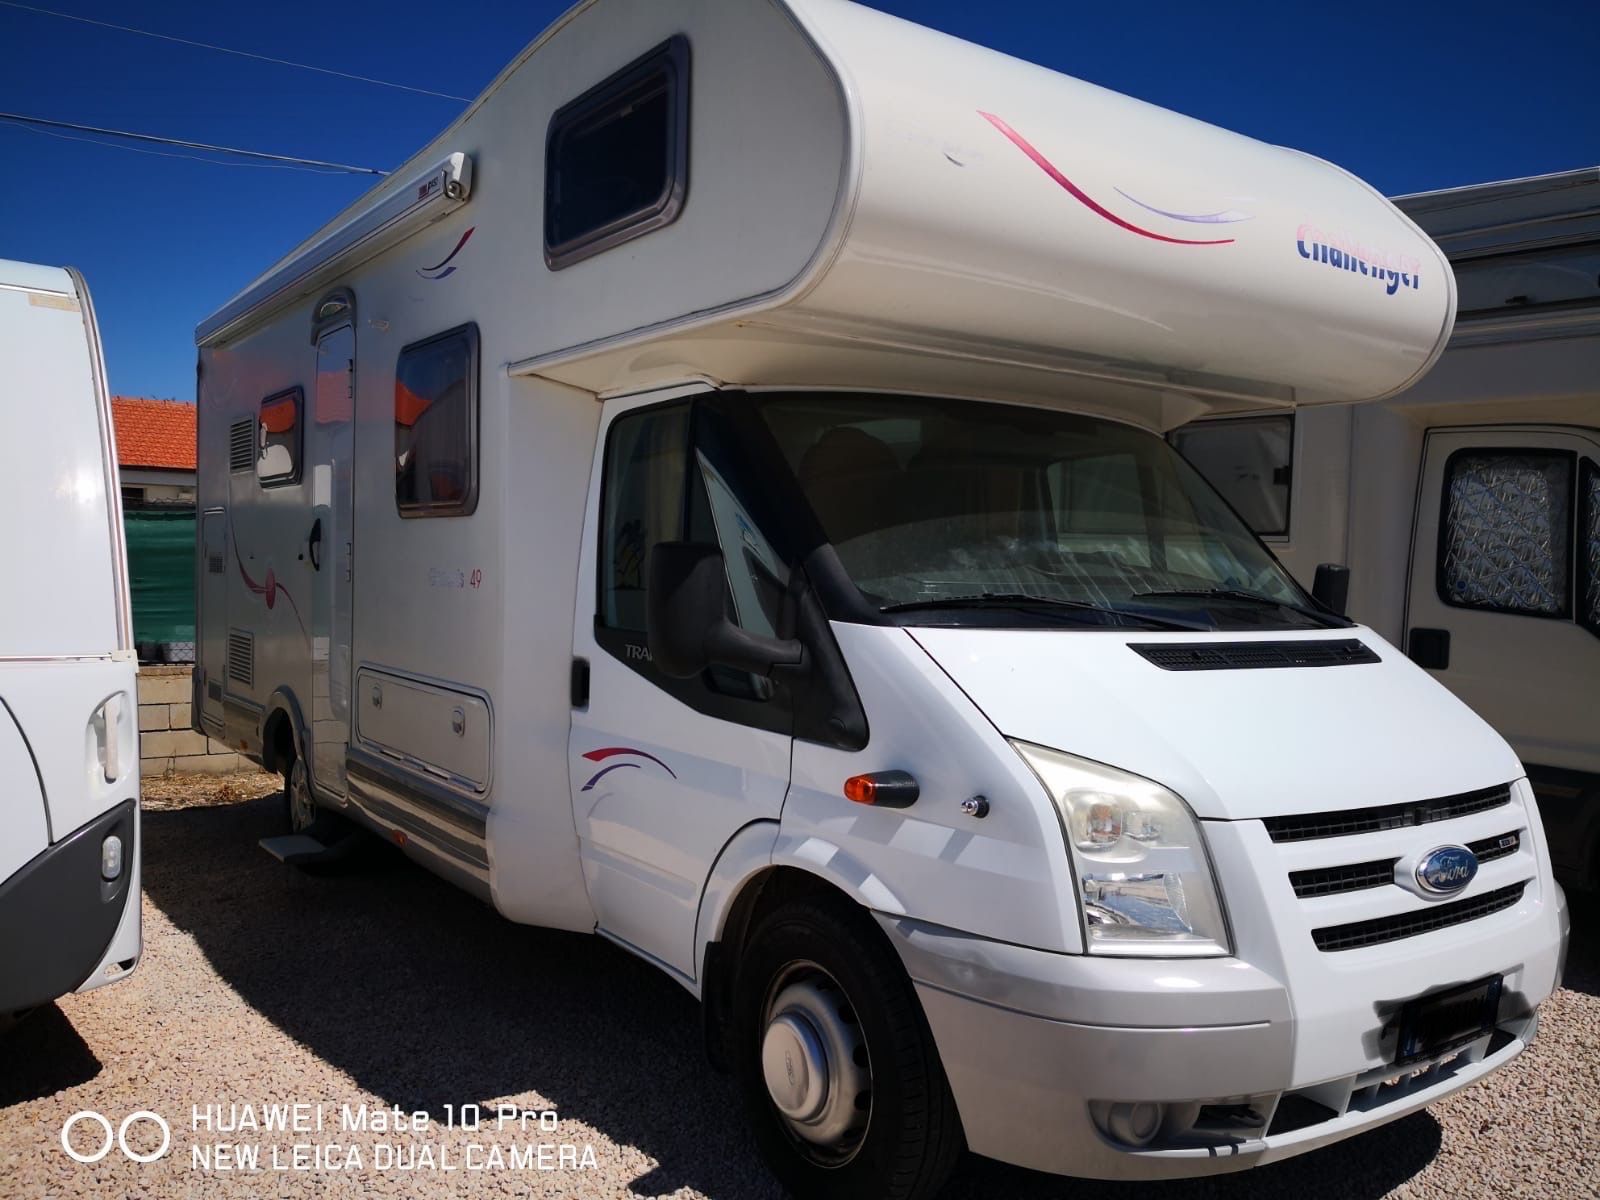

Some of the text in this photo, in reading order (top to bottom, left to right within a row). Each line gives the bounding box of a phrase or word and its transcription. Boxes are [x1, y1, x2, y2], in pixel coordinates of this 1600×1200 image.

[1296, 223, 1421, 295] Challenger
[470, 568, 482, 589] 49
[1436, 855, 1469, 883] Ford
